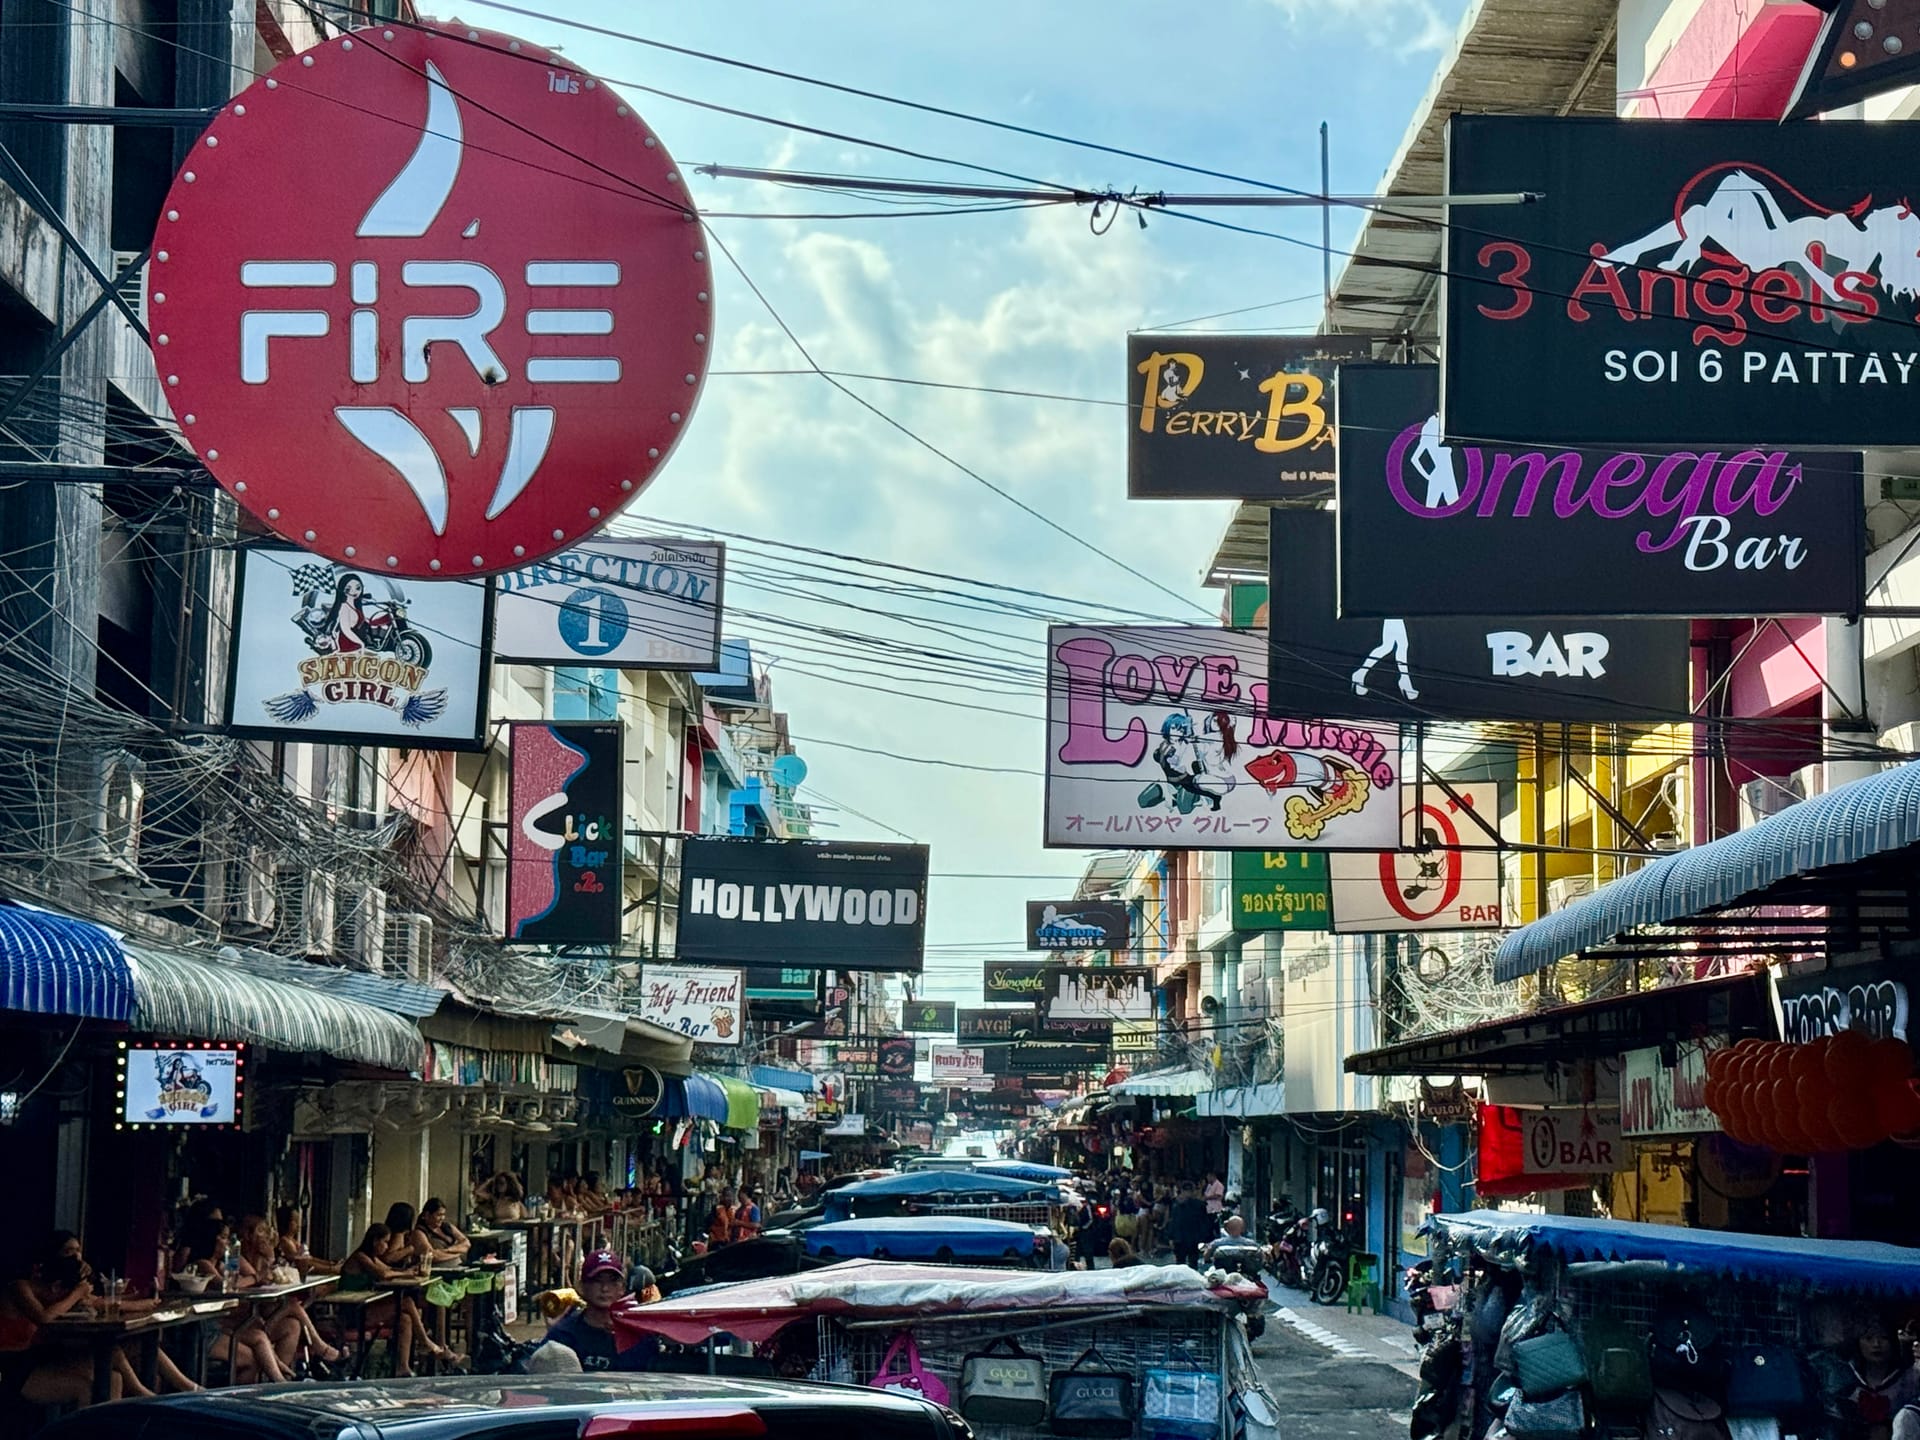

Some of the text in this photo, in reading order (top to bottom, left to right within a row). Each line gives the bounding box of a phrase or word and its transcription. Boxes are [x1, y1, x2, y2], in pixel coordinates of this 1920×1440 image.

[1477, 241, 1878, 346] 3 Angels
[241, 261, 621, 384] FIRE
[1605, 350, 1677, 382] SOI
[1699, 349, 1723, 382] 6
[1386, 421, 1802, 552] Omega
[1680, 515, 1807, 571] Bar
[646, 640, 699, 660] Bar
[1486, 631, 1610, 679] BAR
[299, 655, 427, 692] SAIGON
[324, 681, 395, 707] GIRL
[1056, 637, 1242, 768] LOVE
[570, 845, 608, 868] Bar
[690, 878, 918, 925] HOLLYWOOD
[1241, 884, 1327, 922] ของรัฐบาล
[1459, 904, 1499, 922] BAR
[1040, 936, 1067, 947] BAR
[647, 975, 738, 1015] My Friend
[680, 1016, 710, 1037] Bar
[934, 1054, 962, 1068] Ruby
[612, 1095, 657, 1106] GUINNESS
[1559, 1140, 1614, 1165] BAR
[990, 1368, 1028, 1380] GUCCI
[1076, 1386, 1115, 1398] GUCCI
